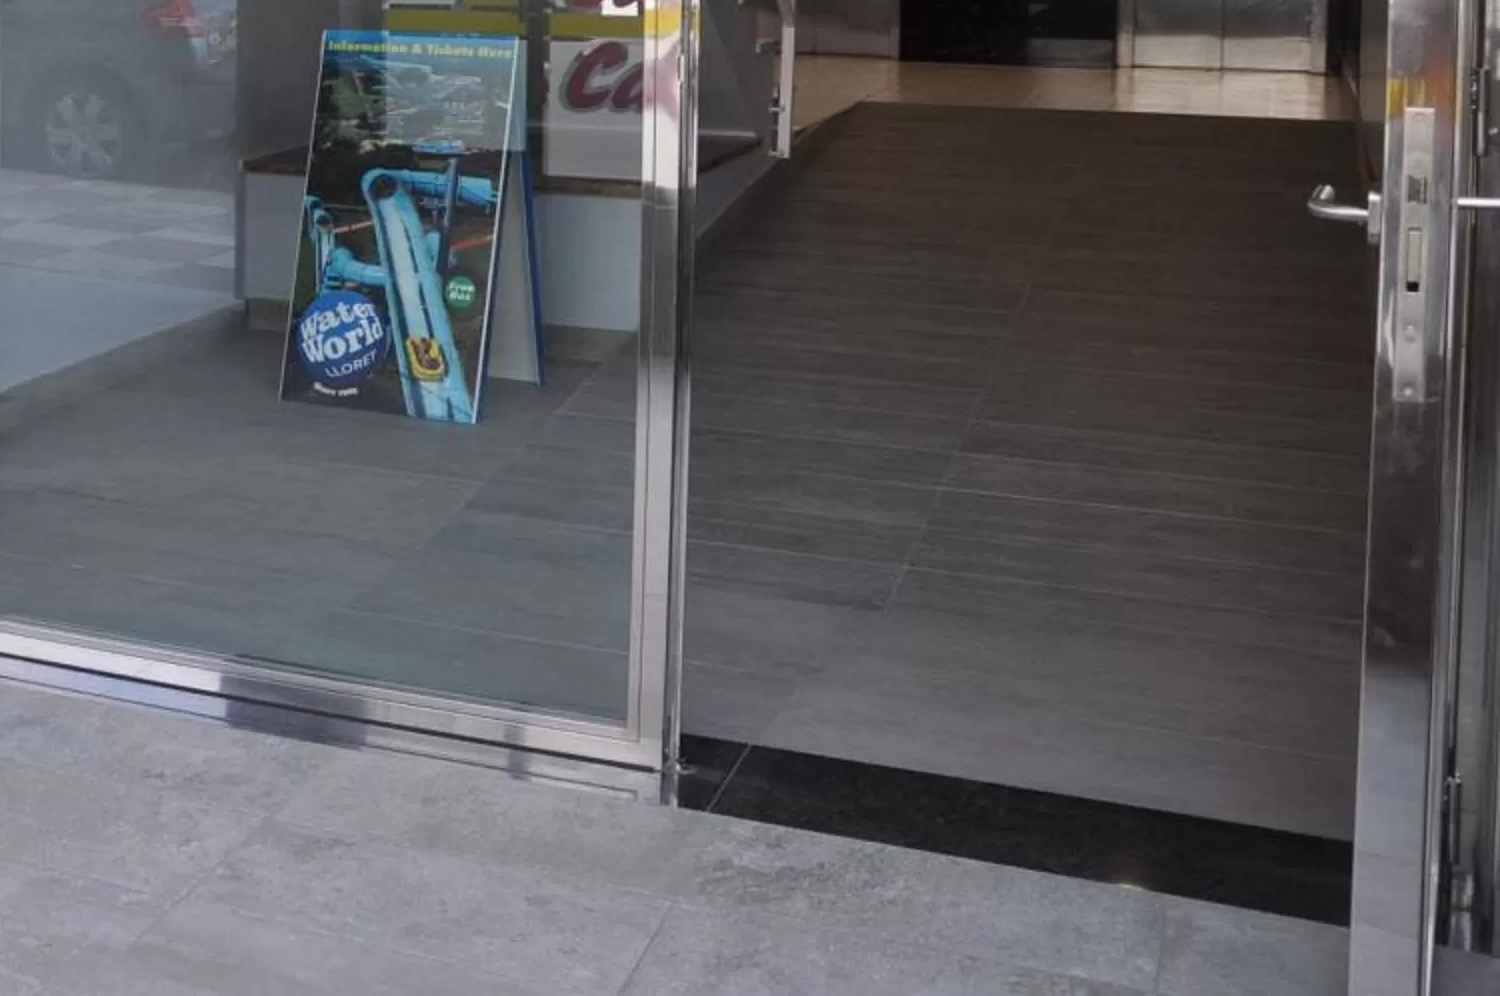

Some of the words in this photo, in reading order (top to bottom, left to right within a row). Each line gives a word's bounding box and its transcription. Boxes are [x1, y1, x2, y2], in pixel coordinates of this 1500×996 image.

[301, 301, 376, 342] Water
[302, 316, 384, 363] World
[324, 348, 378, 379] LLORET
